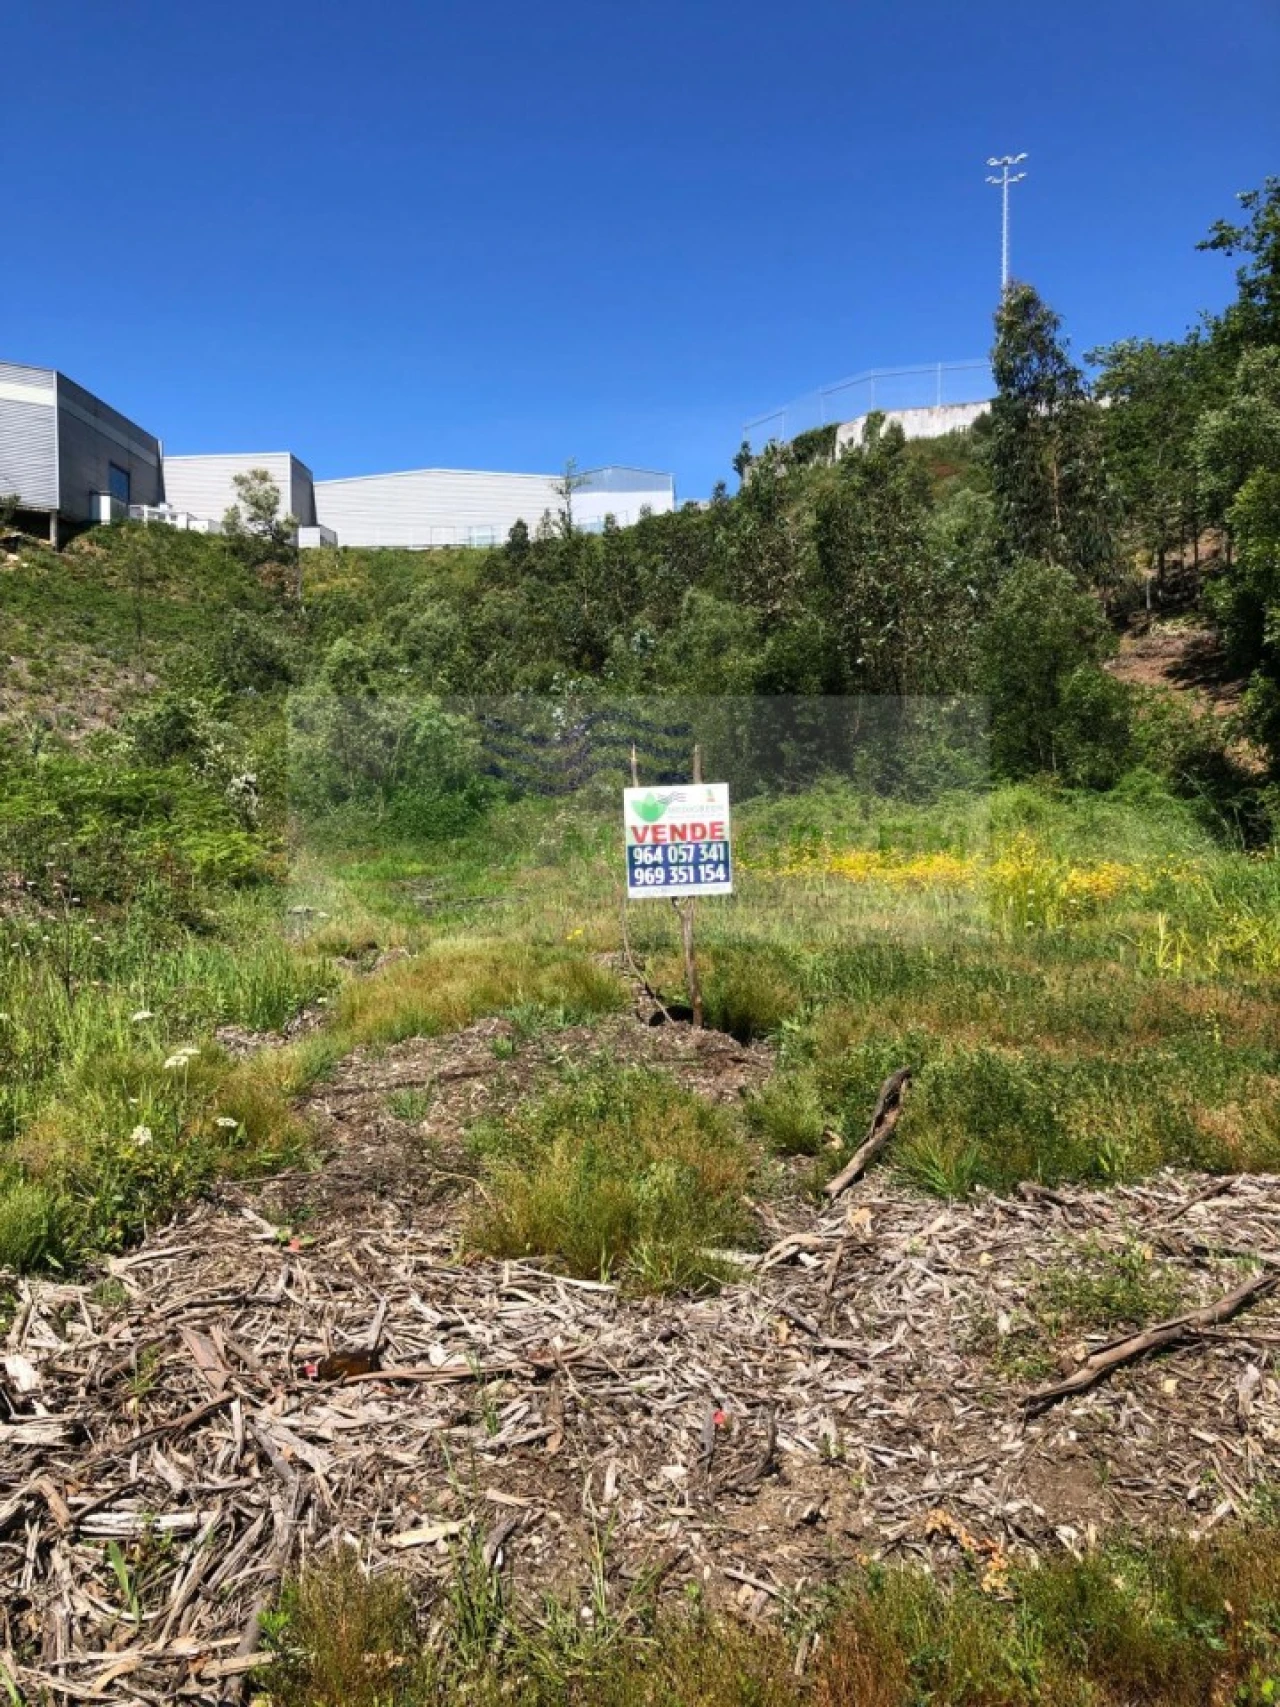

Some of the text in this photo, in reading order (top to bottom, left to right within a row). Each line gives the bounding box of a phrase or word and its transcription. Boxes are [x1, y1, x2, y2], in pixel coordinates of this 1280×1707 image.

[631, 822, 725, 844] VENDE
[633, 843, 725, 865] 964 057 341
[634, 864, 726, 885] 969 351 154
